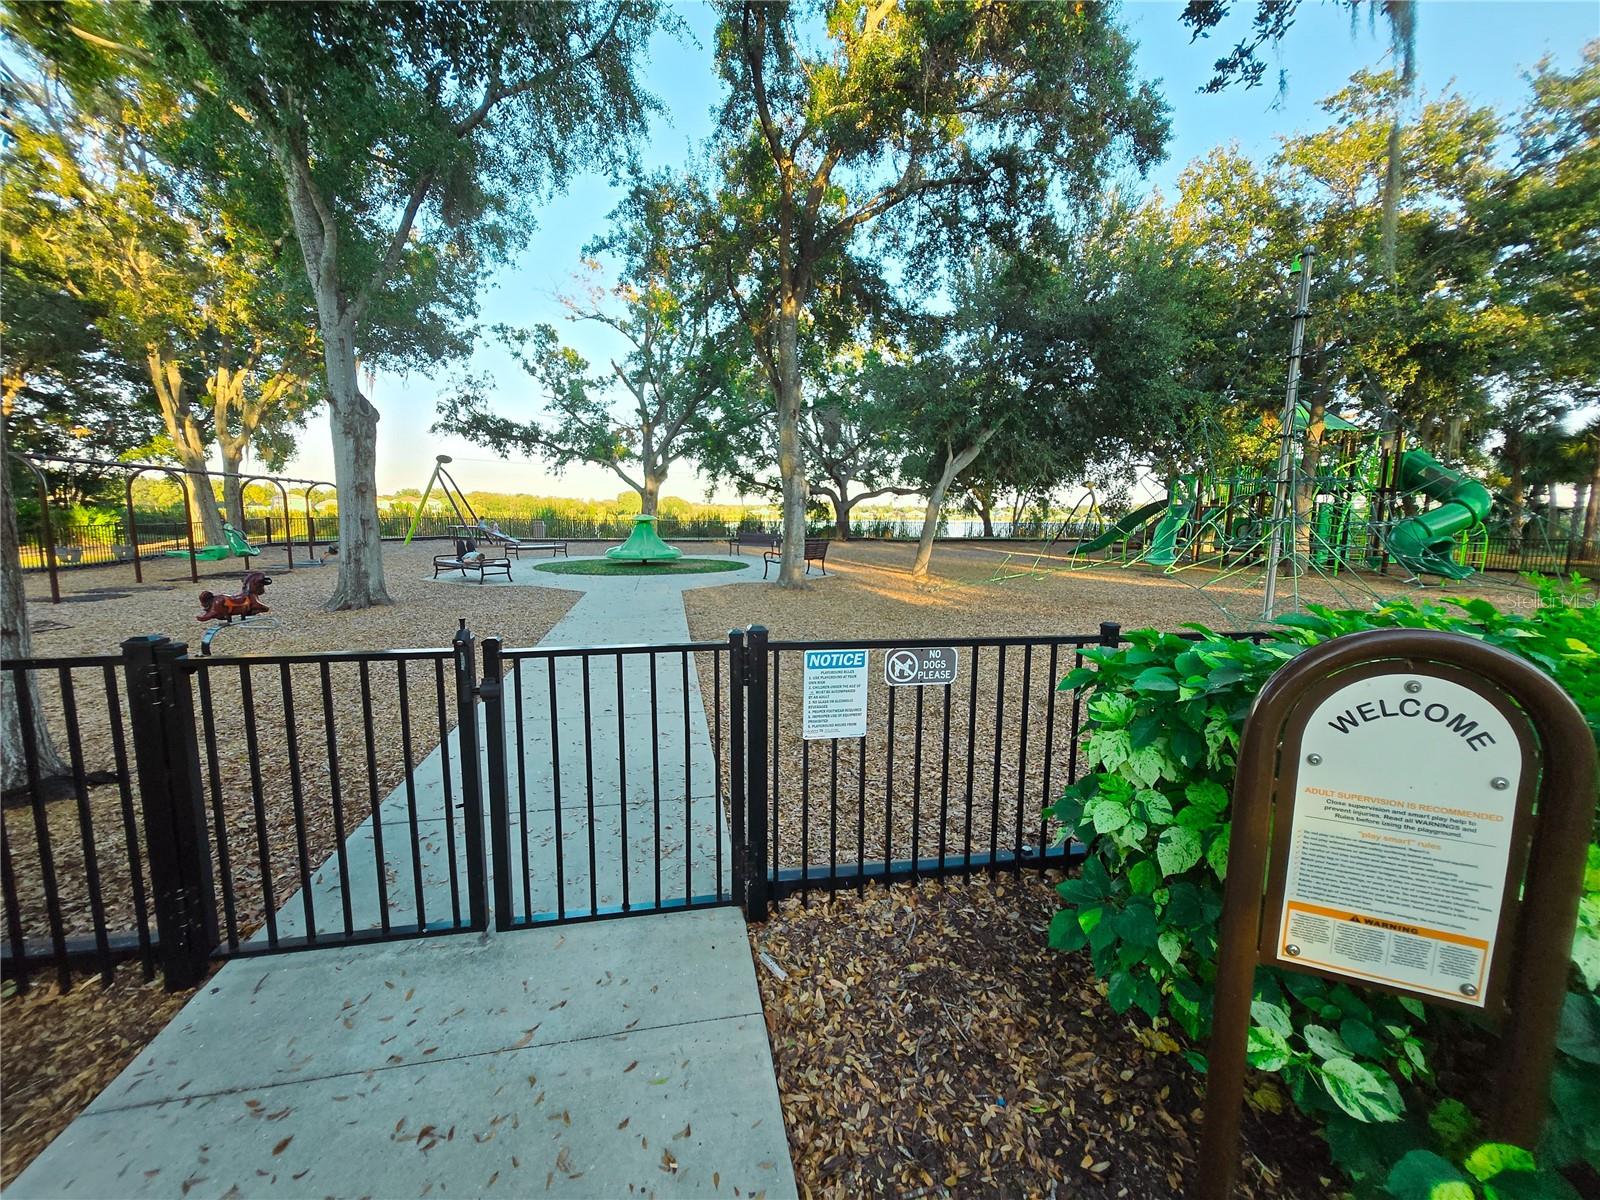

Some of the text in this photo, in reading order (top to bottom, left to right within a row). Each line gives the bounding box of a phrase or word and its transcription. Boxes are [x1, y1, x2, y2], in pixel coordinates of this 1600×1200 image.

[809, 653, 864, 666] NOTICE
[929, 650, 941, 658] NO
[923, 660, 946, 669] DOGS
[918, 670, 951, 680] PLEASE
[1328, 698, 1496, 752] WELCOME
[1305, 787, 1334, 798] ADULT
[1338, 792, 1404, 808] SUPERVISION
[1418, 804, 1504, 822] RECOMMENDED
[1348, 803, 1390, 813] supervision
[1324, 805, 1352, 814] prevent
[1353, 809, 1381, 818] injuries.
[1415, 819, 1460, 830] WARNINGS
[1356, 816, 1380, 825] before
[1417, 826, 1462, 837] playground.
[1418, 841, 1441, 850] rules
[1364, 918, 1418, 934] WARNING
